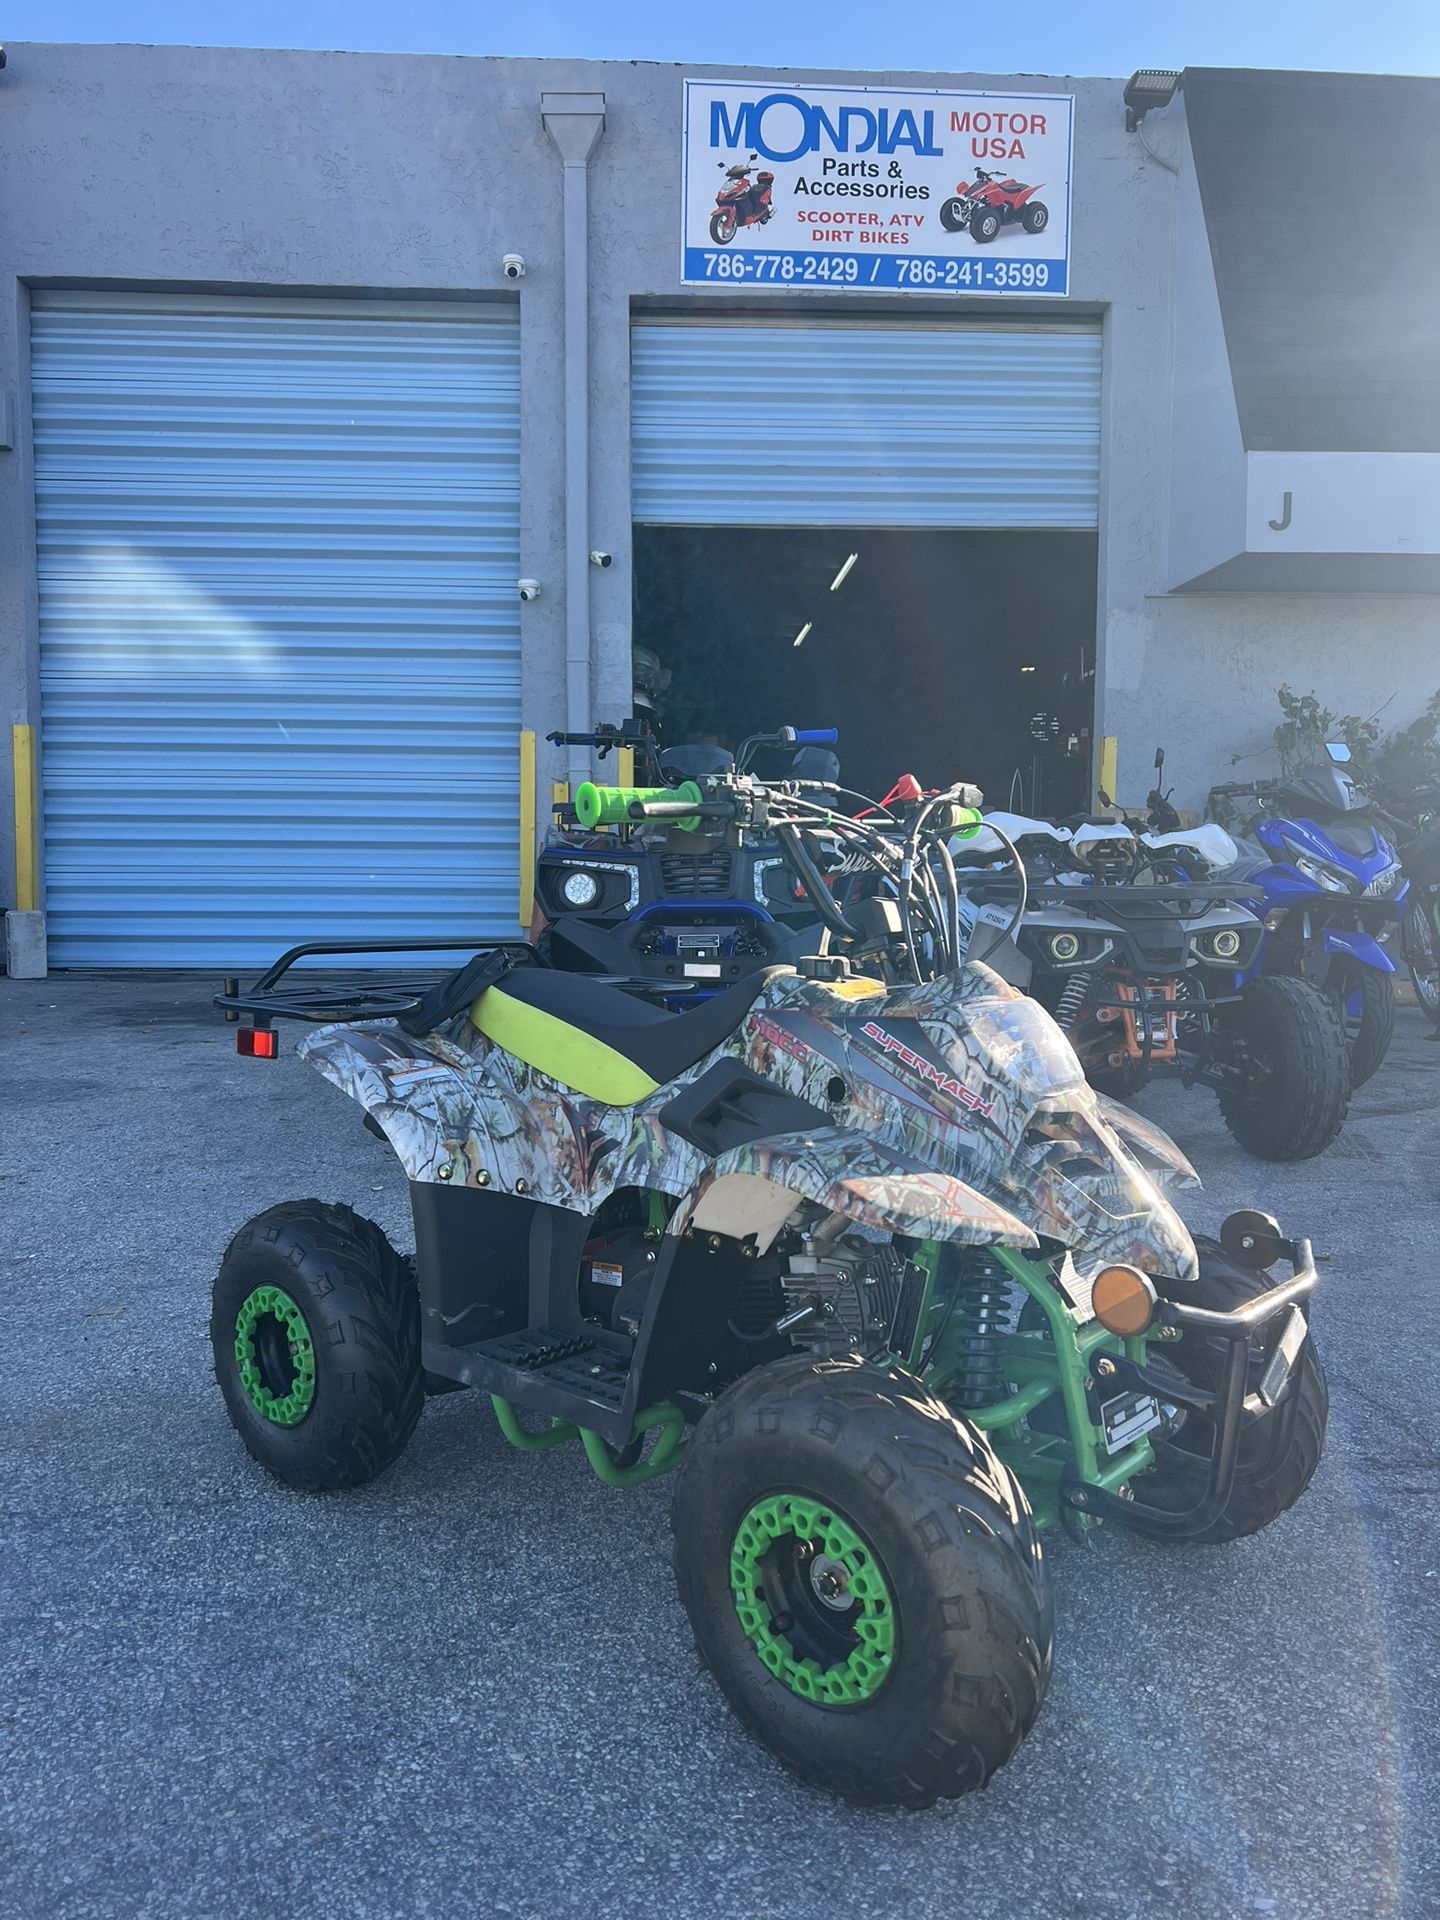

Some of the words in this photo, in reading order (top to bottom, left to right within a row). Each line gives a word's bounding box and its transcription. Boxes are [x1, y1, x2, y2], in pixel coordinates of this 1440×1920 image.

[710, 93, 943, 163] MONDIAL
[950, 111, 1047, 135] MOTOR
[971, 138, 1026, 160] USA
[822, 158, 880, 178] Parts
[887, 160, 903, 179] &
[793, 176, 930, 200] Accessories
[797, 210, 884, 228] SCOOTER,
[889, 213, 925, 228] ATV
[812, 229, 854, 242] DIRT
[859, 231, 910, 245] BIKES
[703, 253, 859, 282] 786-778-2429
[869, 257, 881, 282] /
[896, 259, 1049, 288] 786-241-3599
[1268, 491, 1293, 531] J
[859, 1021, 996, 1118] SUPERMACH
